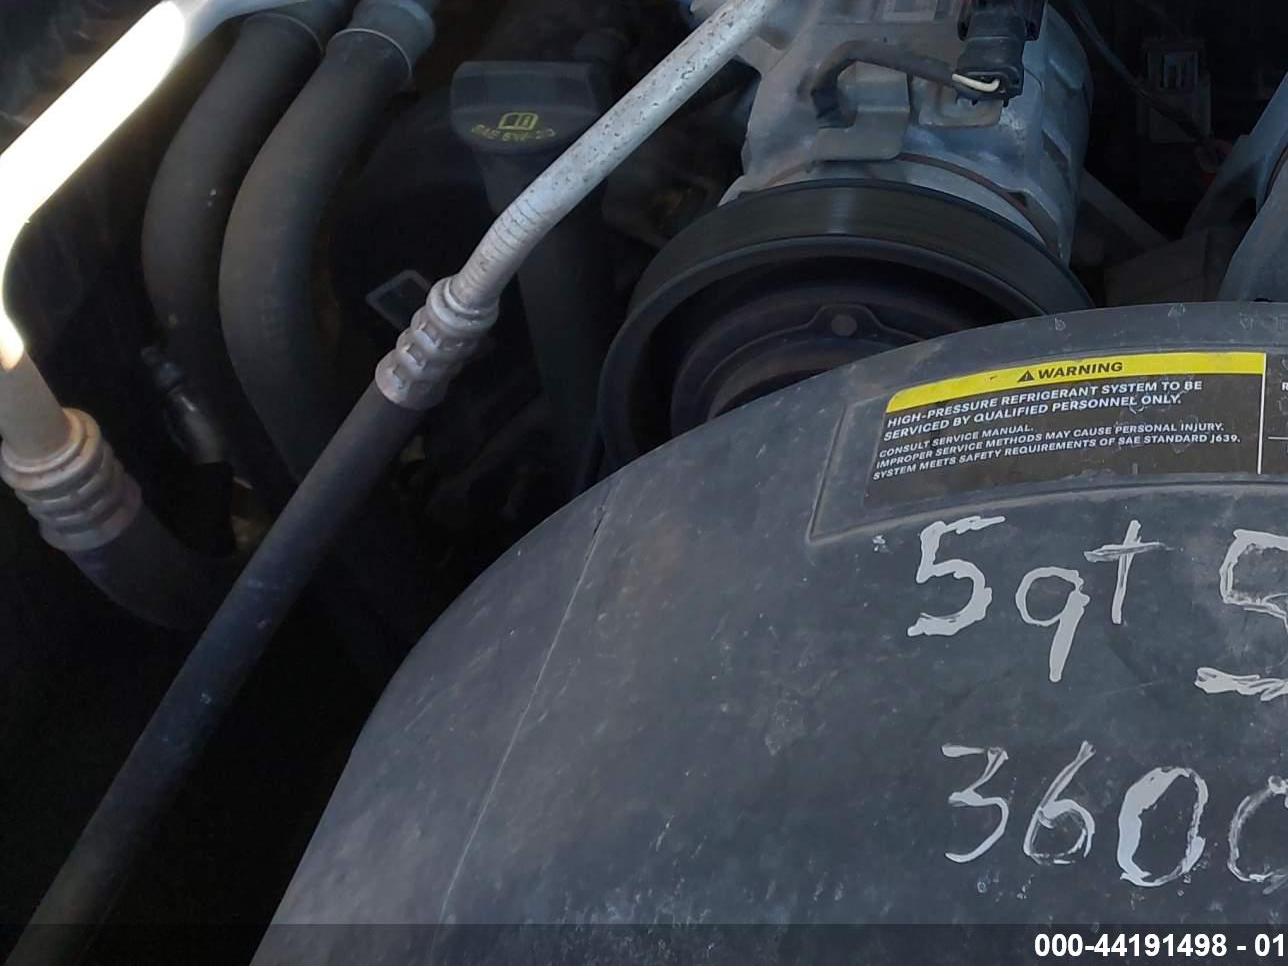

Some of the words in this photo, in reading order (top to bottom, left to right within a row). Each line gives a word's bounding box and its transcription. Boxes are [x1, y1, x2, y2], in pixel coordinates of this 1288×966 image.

[1038, 362, 1123, 379] WARNING
[884, 419, 950, 441] SERVICED
[953, 415, 972, 427] BY
[974, 404, 1049, 423] QUALIFIED
[1052, 396, 1138, 412] PERSONNEL
[1141, 394, 1182, 405] ONLY.
[887, 397, 998, 428] HIGH-PRESSURE
[1001, 386, 1098, 406] REFRIGERANT
[1101, 382, 1157, 394] SYSTEM
[1161, 381, 1180, 391] TO
[1184, 381, 1203, 390] BE
[872, 464, 917, 481] SYSTEM
[919, 458, 956, 471] MEETS
[958, 450, 1001, 463] SAFETY
[1004, 439, 1096, 456] REQUIREMENTS
[1099, 438, 1116, 446] OF
[1118, 436, 1140, 445] SAE
[1143, 434, 1208, 444] STANDARD
[1209, 434, 1241, 444] J639.
[876, 450, 933, 469] IMPROPER
[935, 442, 983, 456] SERVICE
[985, 434, 1042, 447] METHODS
[1045, 430, 1071, 440] MAY
[1073, 427, 1112, 437] CAUSE
[1115, 424, 1177, 434] PERSONAL
[1180, 423, 1224, 431] INJURY.
[879, 440, 929, 458] CONSULT
[932, 432, 979, 447] SERVICE
[981, 424, 1034, 438] MANUAL.
